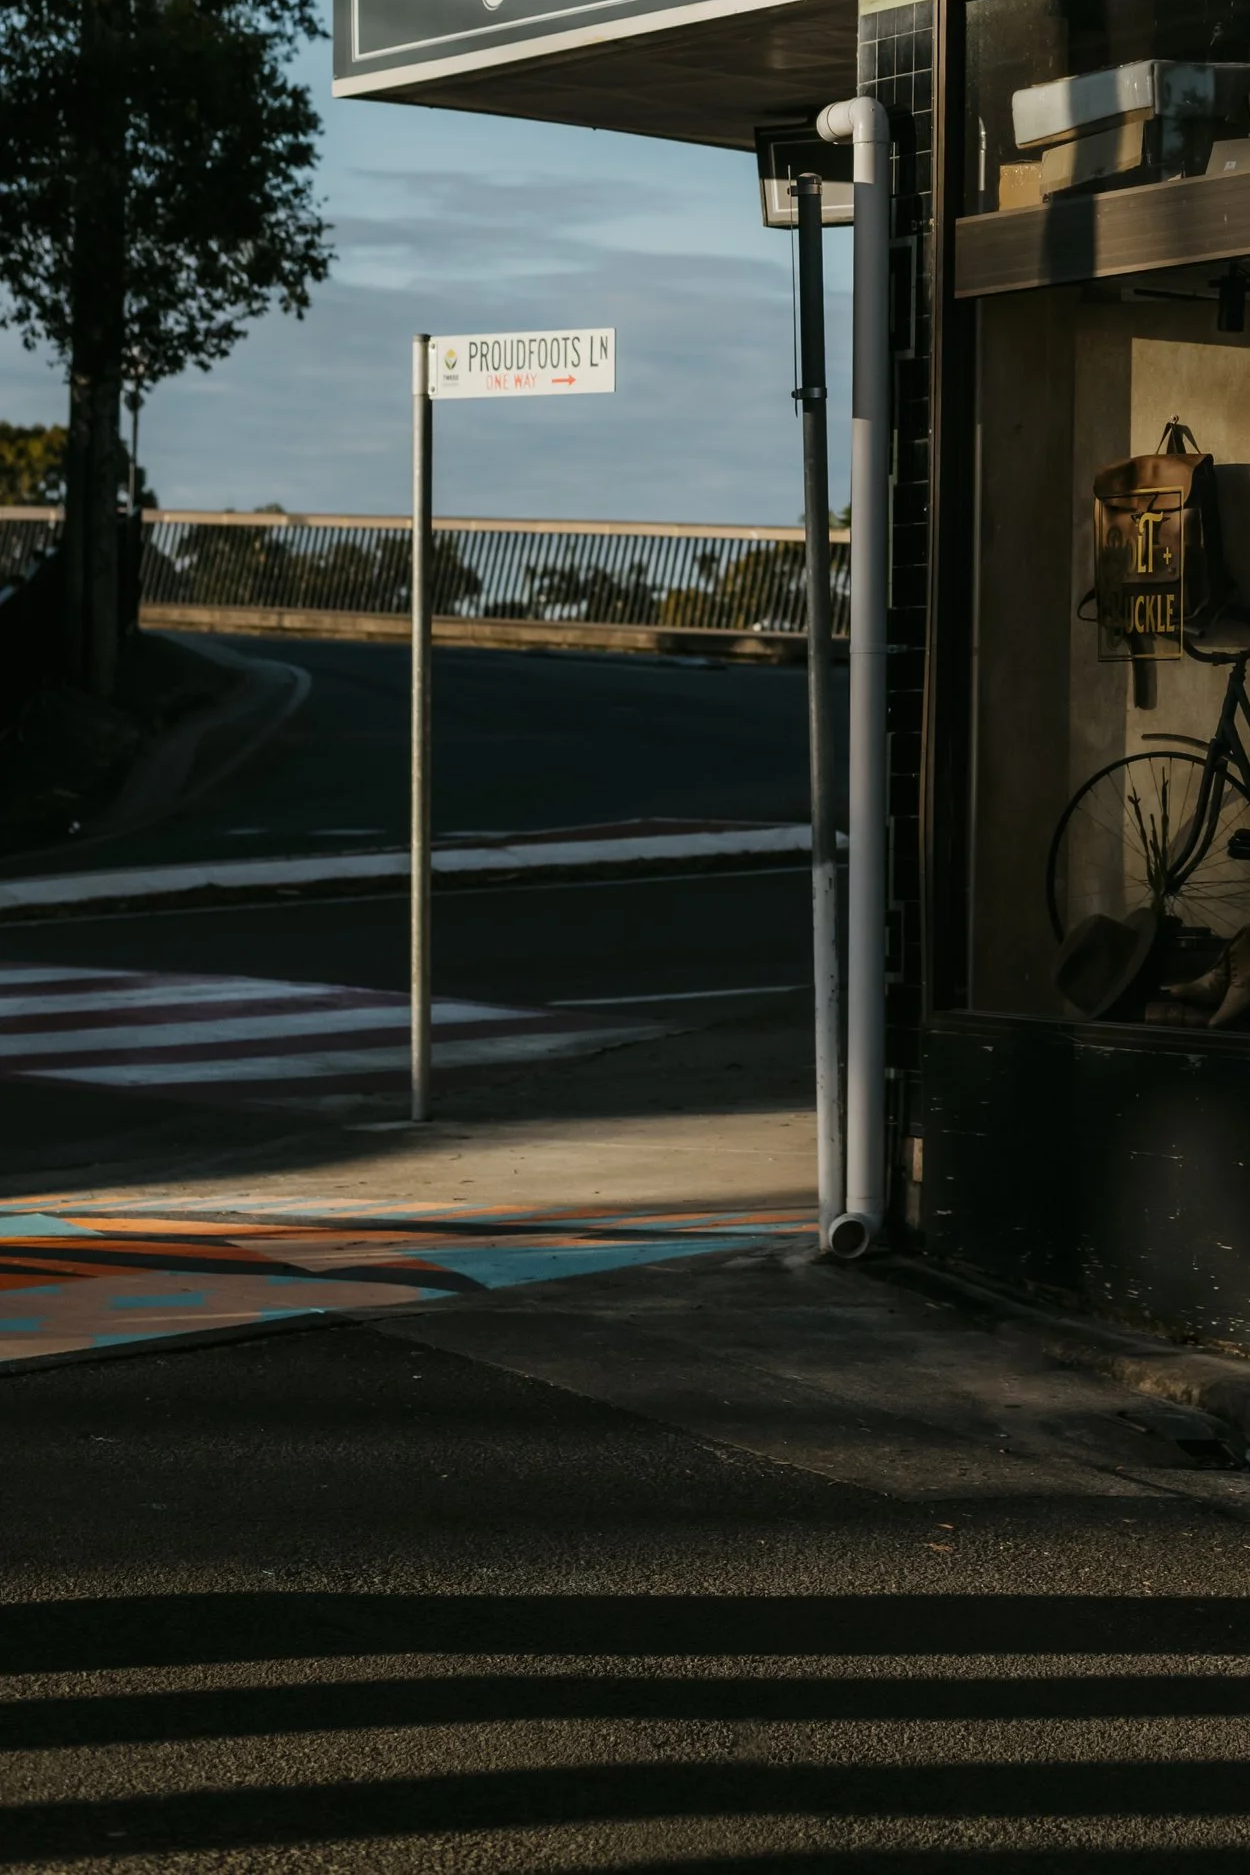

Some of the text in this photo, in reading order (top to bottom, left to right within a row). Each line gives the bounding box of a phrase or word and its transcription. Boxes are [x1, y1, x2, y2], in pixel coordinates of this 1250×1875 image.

[468, 336, 582, 372] PROUDFOOTS
[486, 374, 538, 390] ONE WAY
